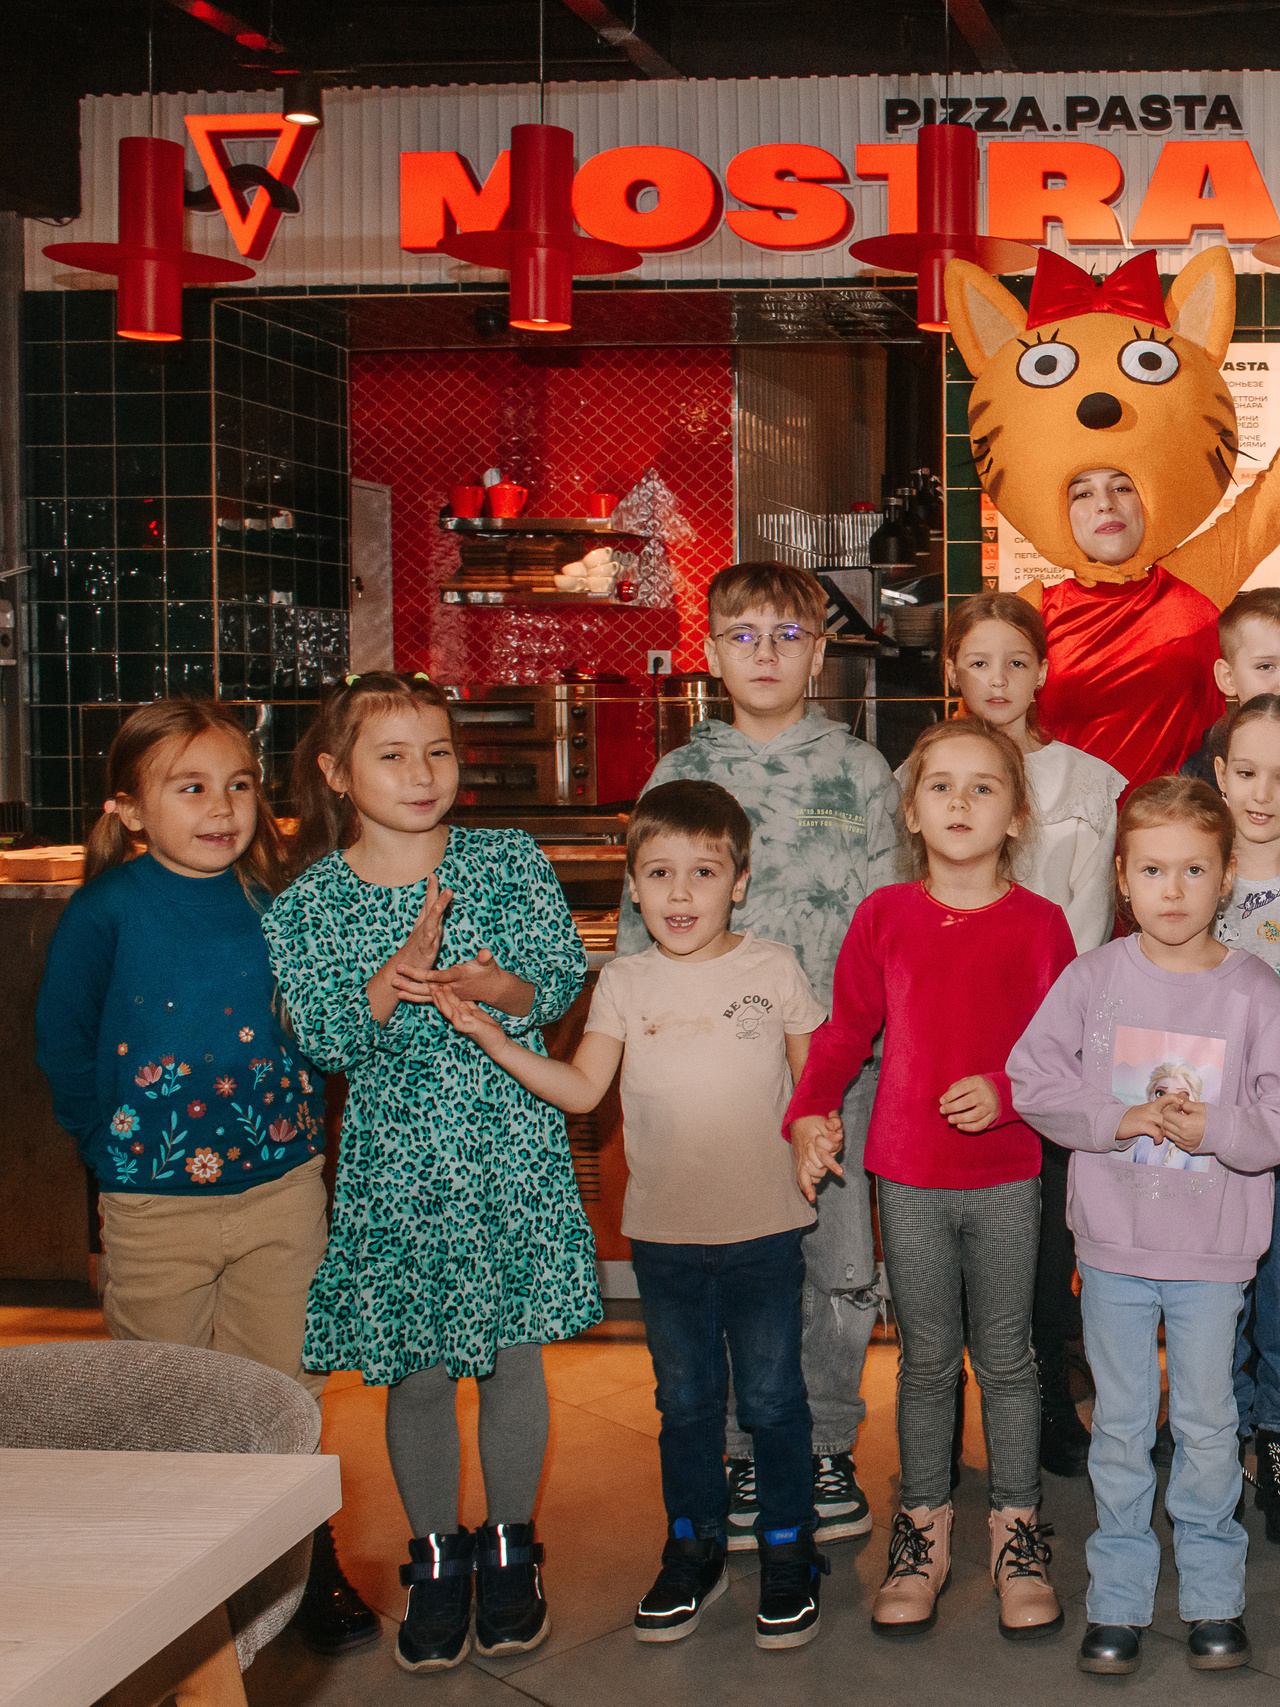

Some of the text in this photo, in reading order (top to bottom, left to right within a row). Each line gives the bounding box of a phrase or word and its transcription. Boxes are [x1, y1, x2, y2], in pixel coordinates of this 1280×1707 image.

[885, 94, 1243, 133] PIZZA.PASTA
[1222, 361, 1270, 372] ASTA
[1226, 380, 1264, 388] ОНЬЕЗЕ
[722, 994, 774, 1020] BE COOL
